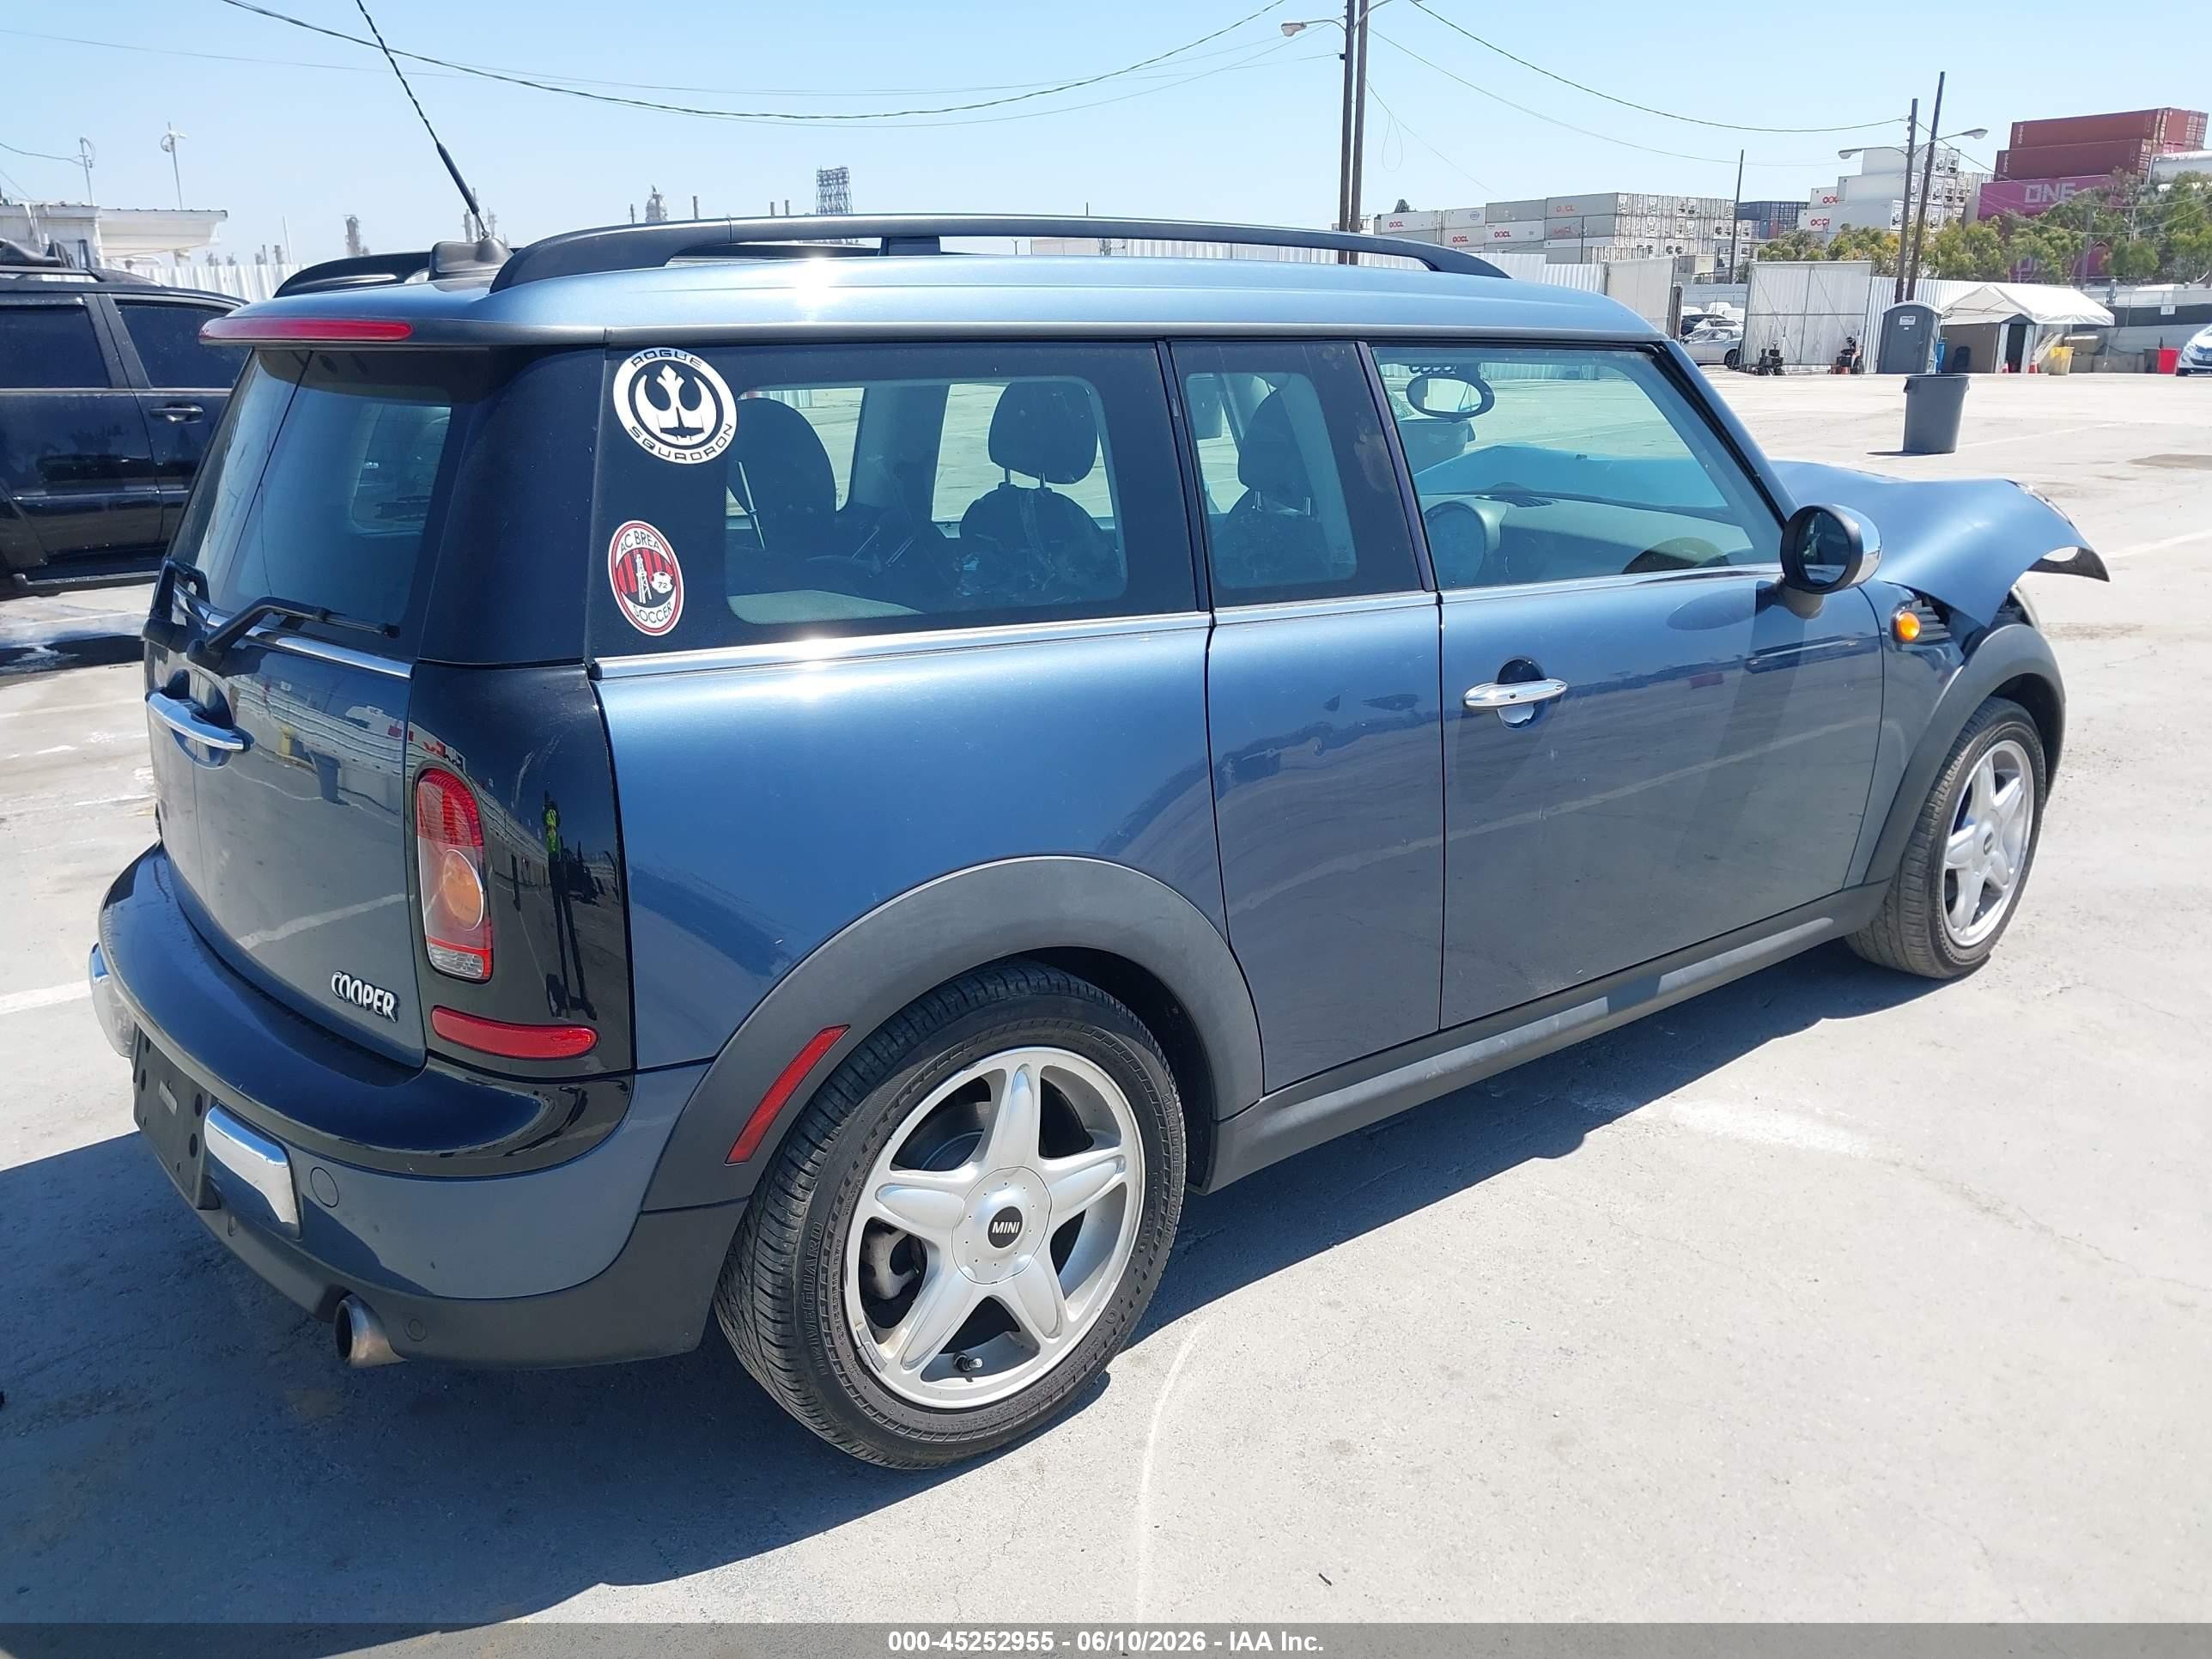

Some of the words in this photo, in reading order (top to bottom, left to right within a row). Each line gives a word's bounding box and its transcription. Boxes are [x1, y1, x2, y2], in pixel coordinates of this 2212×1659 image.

[2024, 183, 2076, 204] ONE
[1493, 230, 1511, 239] OOCL
[630, 349, 703, 369] ROGUE
[629, 422, 733, 461] SQUADRON
[620, 533, 634, 555] AC
[633, 530, 661, 553] BREA
[633, 604, 672, 623] SOCCER
[331, 971, 397, 1023] COOPER
[991, 1221, 1020, 1234] MINI
